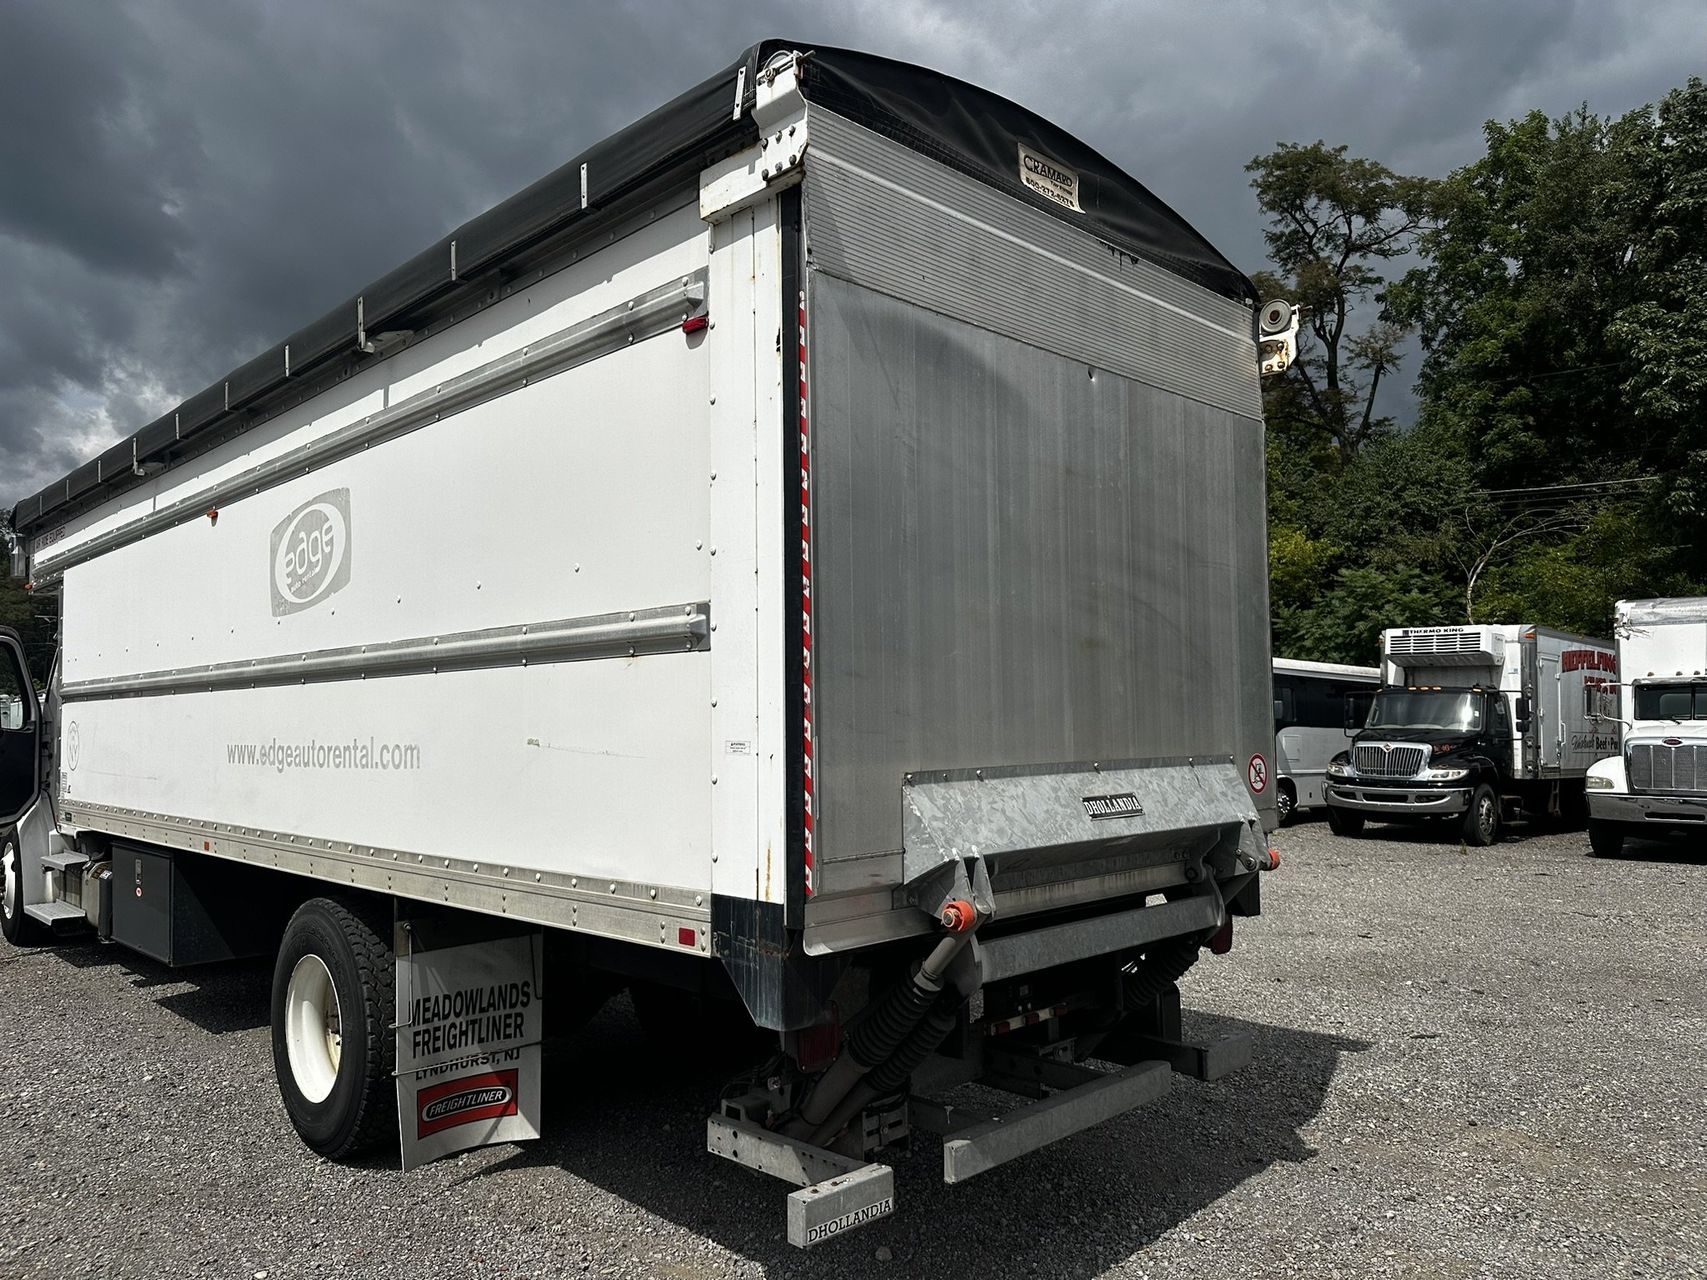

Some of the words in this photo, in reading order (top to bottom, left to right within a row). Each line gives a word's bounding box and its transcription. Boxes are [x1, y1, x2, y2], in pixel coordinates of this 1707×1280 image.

[1024, 155, 1072, 188] CRAMARO
[285, 520, 334, 585] edge
[227, 736, 421, 774] www.edgeautorental.com
[1083, 796, 1142, 815] DHOLLANDIA
[408, 980, 531, 1028] MEADOWLANDS
[412, 1012, 524, 1059] FREIGHTLINER
[415, 1051, 500, 1081] LYNDHURST,
[429, 1090, 503, 1117] FREIGHTLINER
[808, 1199, 891, 1243] DHOLLANDIA
